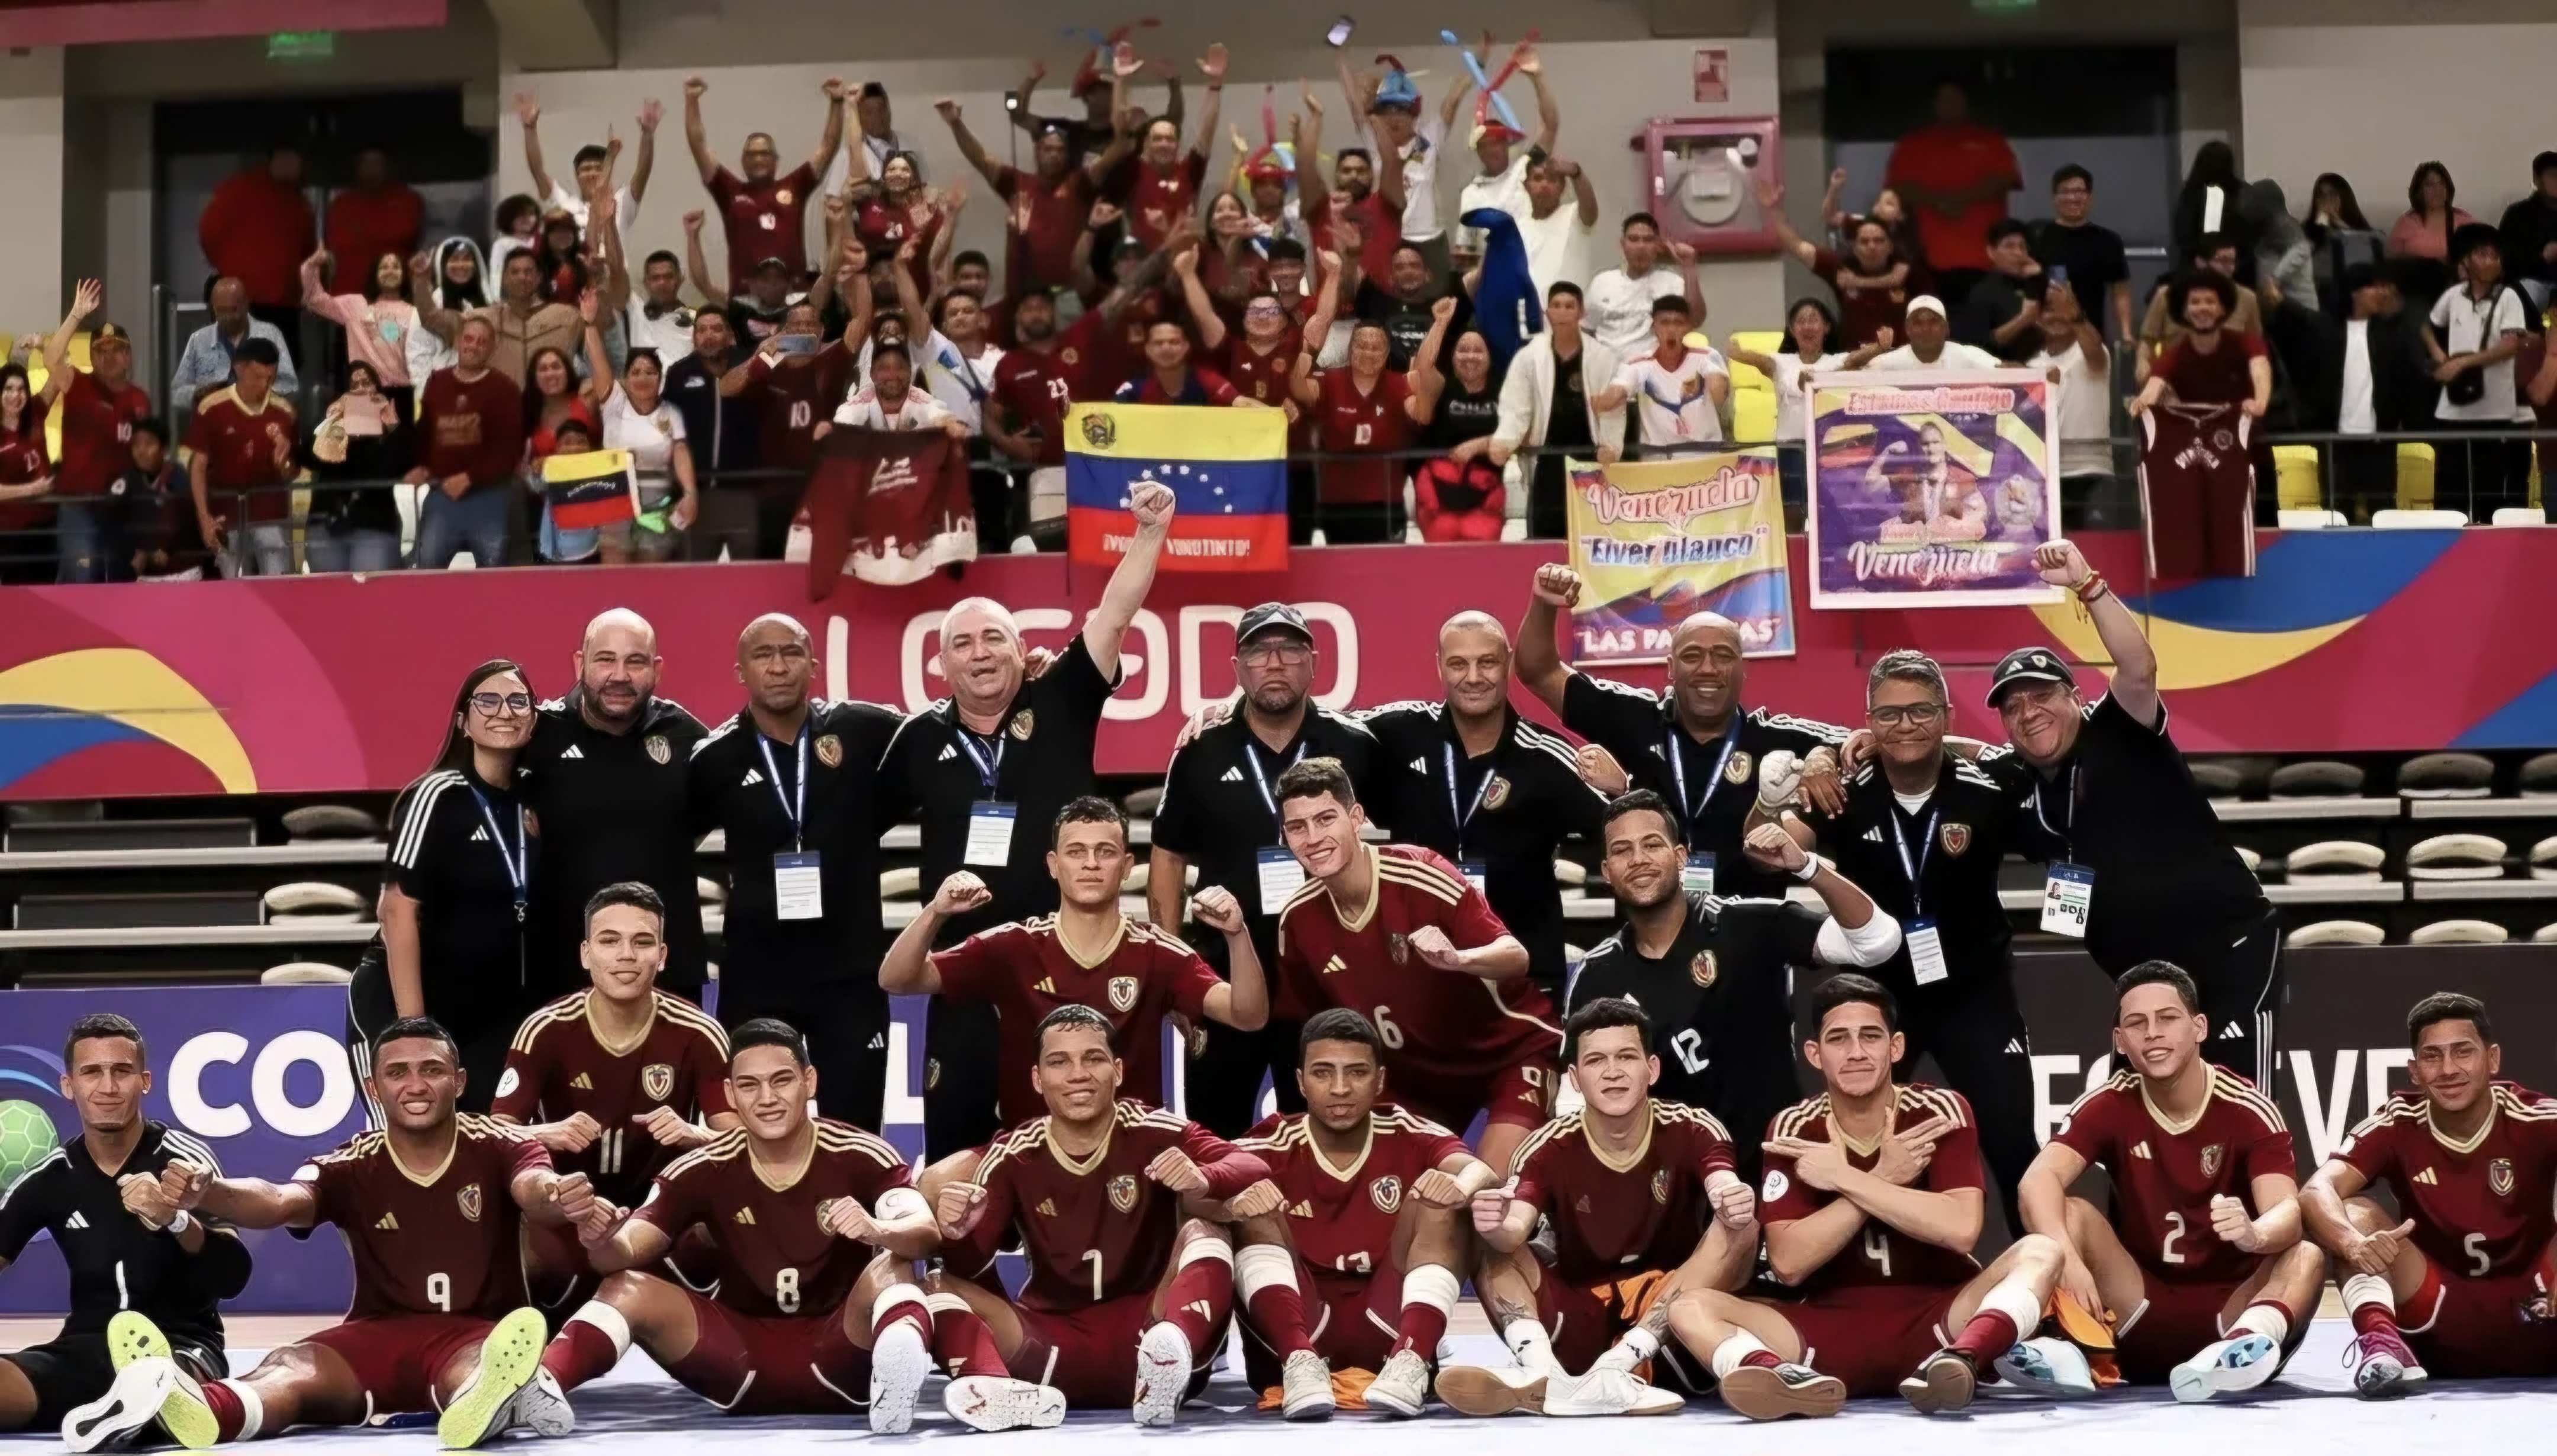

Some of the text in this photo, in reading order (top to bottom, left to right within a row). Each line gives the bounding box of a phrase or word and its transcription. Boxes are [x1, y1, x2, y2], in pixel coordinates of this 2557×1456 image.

[1847, 540, 1999, 586] Venezuela
[1374, 1005, 1404, 1049] 6
[1670, 1027, 1709, 1075] 12
[600, 1128, 623, 1174] 11
[1864, 1229, 1891, 1277] 4
[2162, 1211, 2186, 1264] 2
[2463, 1232, 2491, 1277] 5
[115, 1260, 128, 1310] 1
[427, 1273, 451, 1312] 9
[776, 1268, 800, 1313] 8
